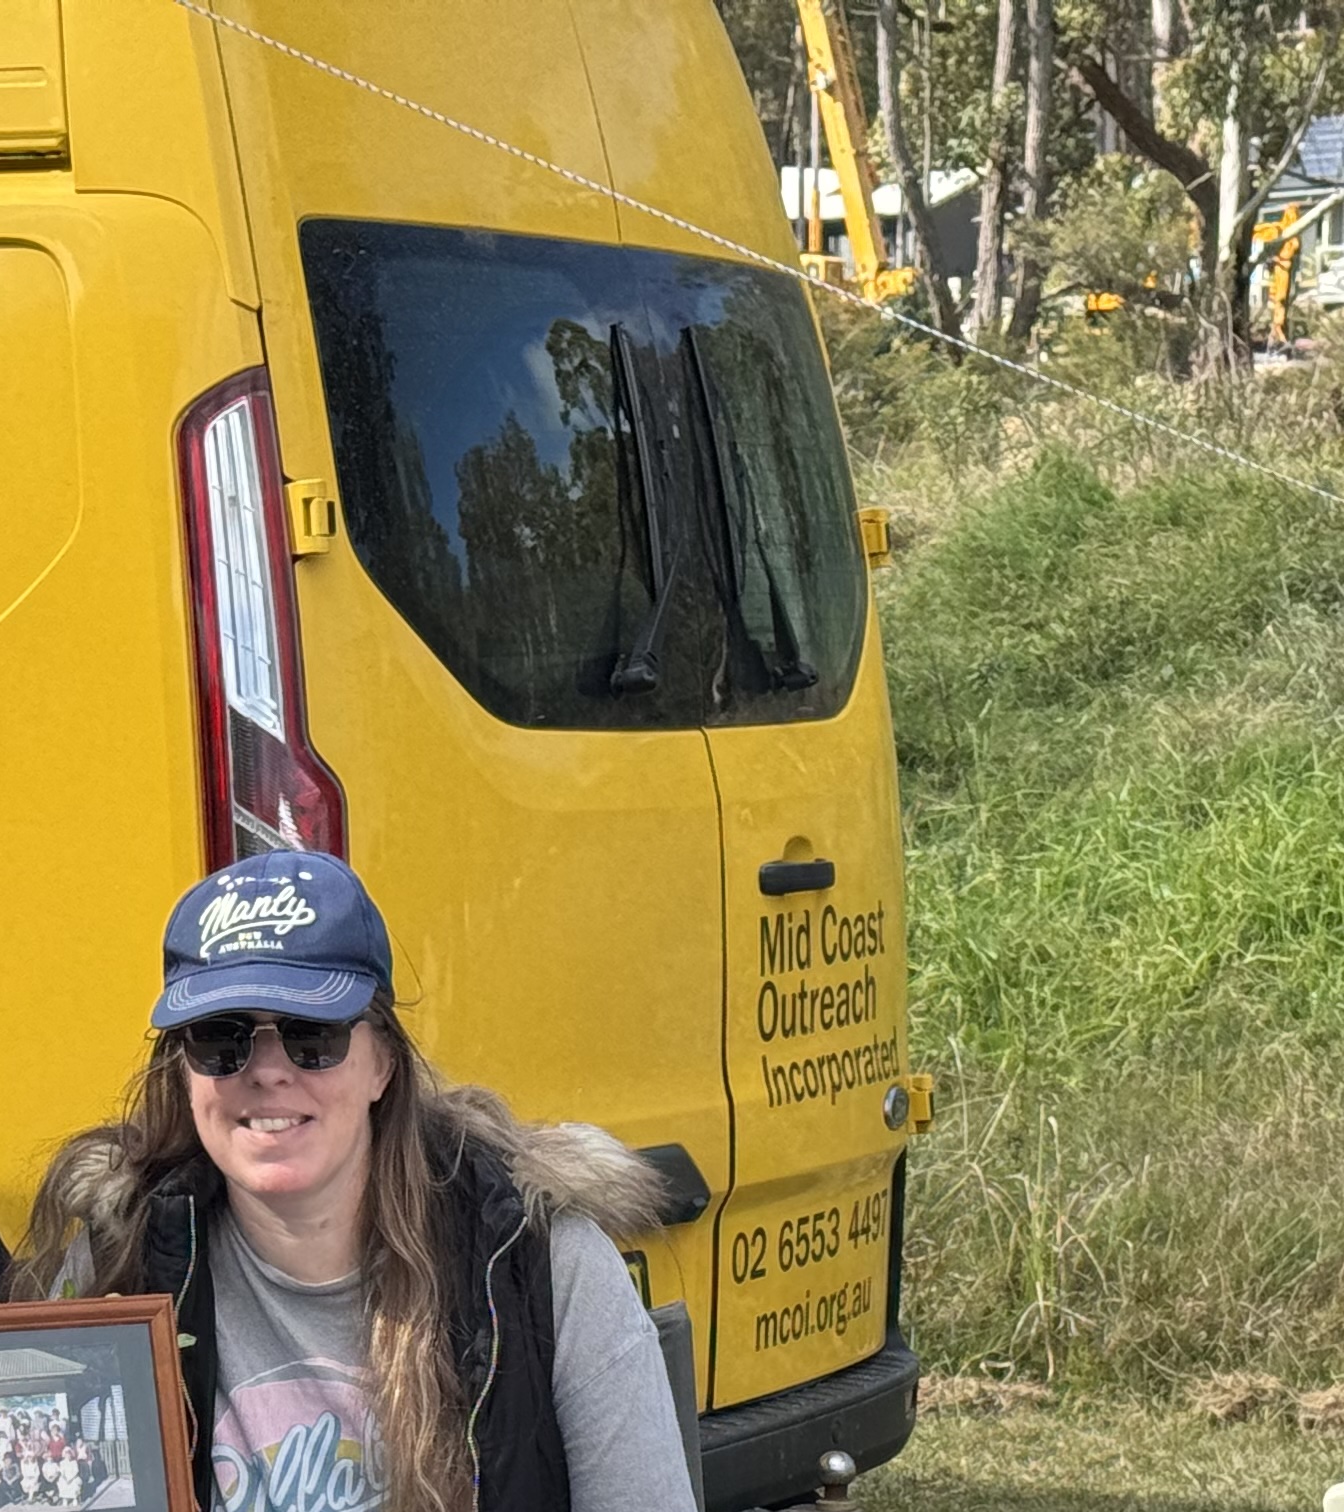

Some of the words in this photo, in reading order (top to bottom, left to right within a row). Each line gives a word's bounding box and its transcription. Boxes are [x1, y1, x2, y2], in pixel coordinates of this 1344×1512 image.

[199, 885, 316, 943] Manly
[218, 939, 284, 954] AUSTRALIA
[760, 909, 812, 978] Mid
[820, 899, 886, 966] Coast
[757, 963, 878, 1044] Outreach
[761, 1026, 900, 1110] Incorporated
[731, 1225, 768, 1286] 02
[777, 1206, 841, 1274] 6553
[847, 1188, 889, 1251] 4497
[755, 1275, 873, 1353] mcoi.org.au
